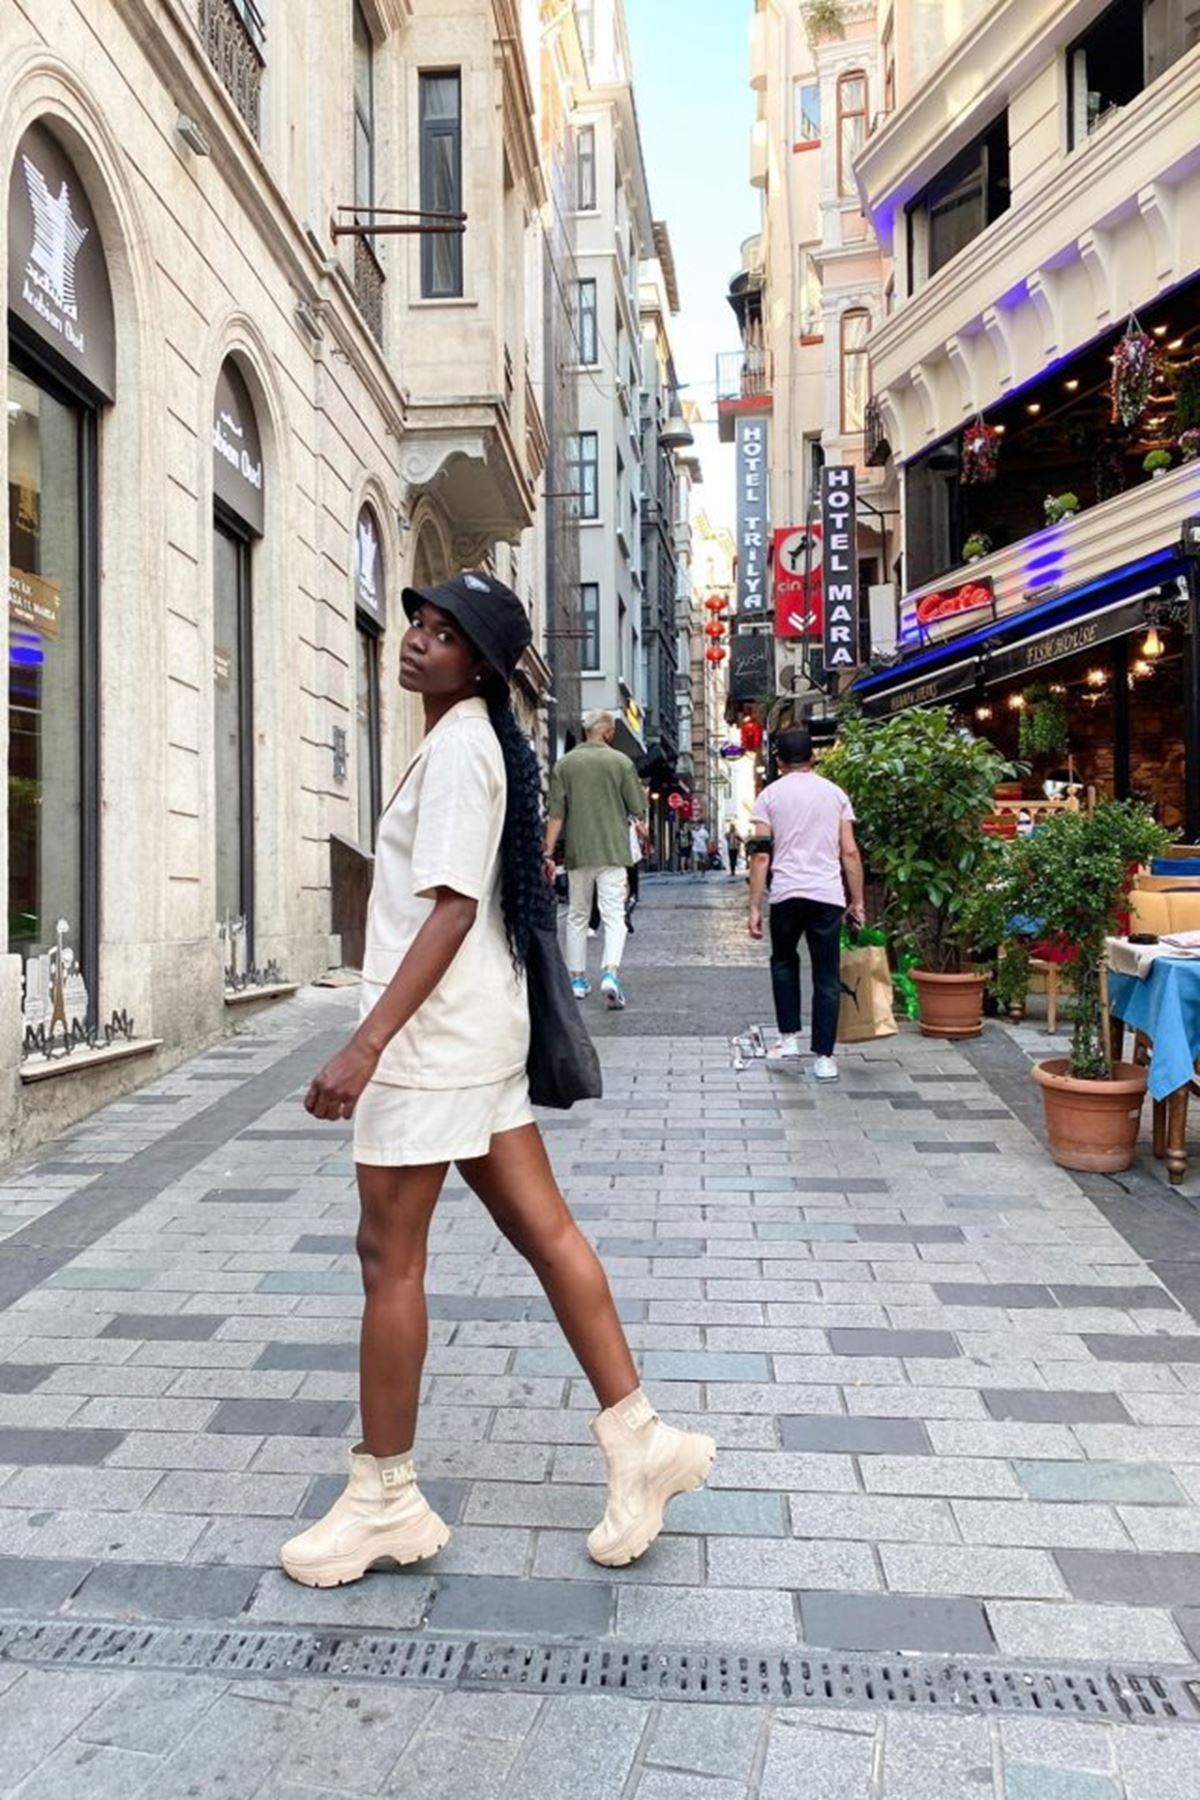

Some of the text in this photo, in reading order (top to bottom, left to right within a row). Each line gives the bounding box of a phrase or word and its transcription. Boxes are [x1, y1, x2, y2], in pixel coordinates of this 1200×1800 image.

[22, 279, 62, 333] Arabian
[64, 320, 85, 353] Oud
[213, 419, 240, 470] bian
[241, 449, 262, 490] Oud
[743, 427, 762, 501] HOTEL
[828, 469, 853, 664] HOTEL MARA
